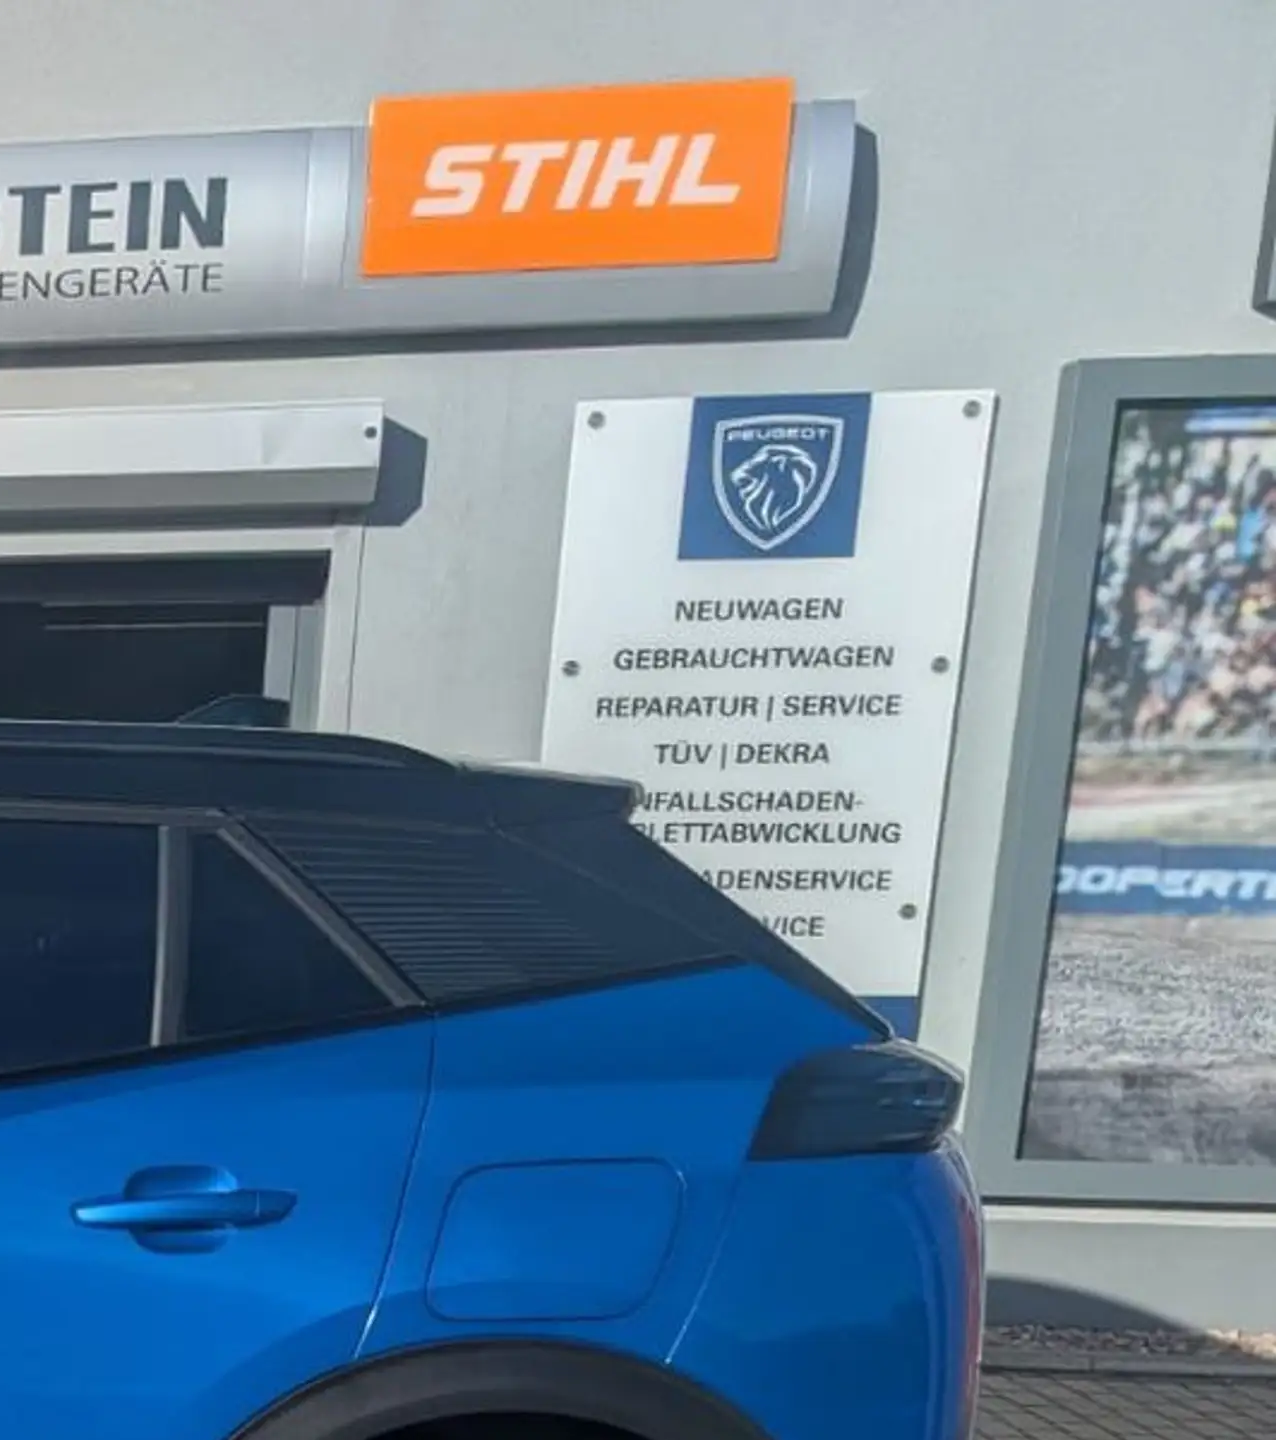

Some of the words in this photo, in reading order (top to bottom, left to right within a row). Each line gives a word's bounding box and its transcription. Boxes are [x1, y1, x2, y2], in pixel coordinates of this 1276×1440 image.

[411, 133, 742, 219] STIHL
[726, 427, 830, 441] PEUGEOT
[675, 598, 844, 622] NEUWAGEN
[614, 646, 894, 671] GEBRAUCHTWAGEN
[596, 696, 758, 718] REPARATUR
[781, 694, 902, 717] SERVICE
[654, 741, 712, 765] TÜV
[735, 743, 830, 765] DEKRA
